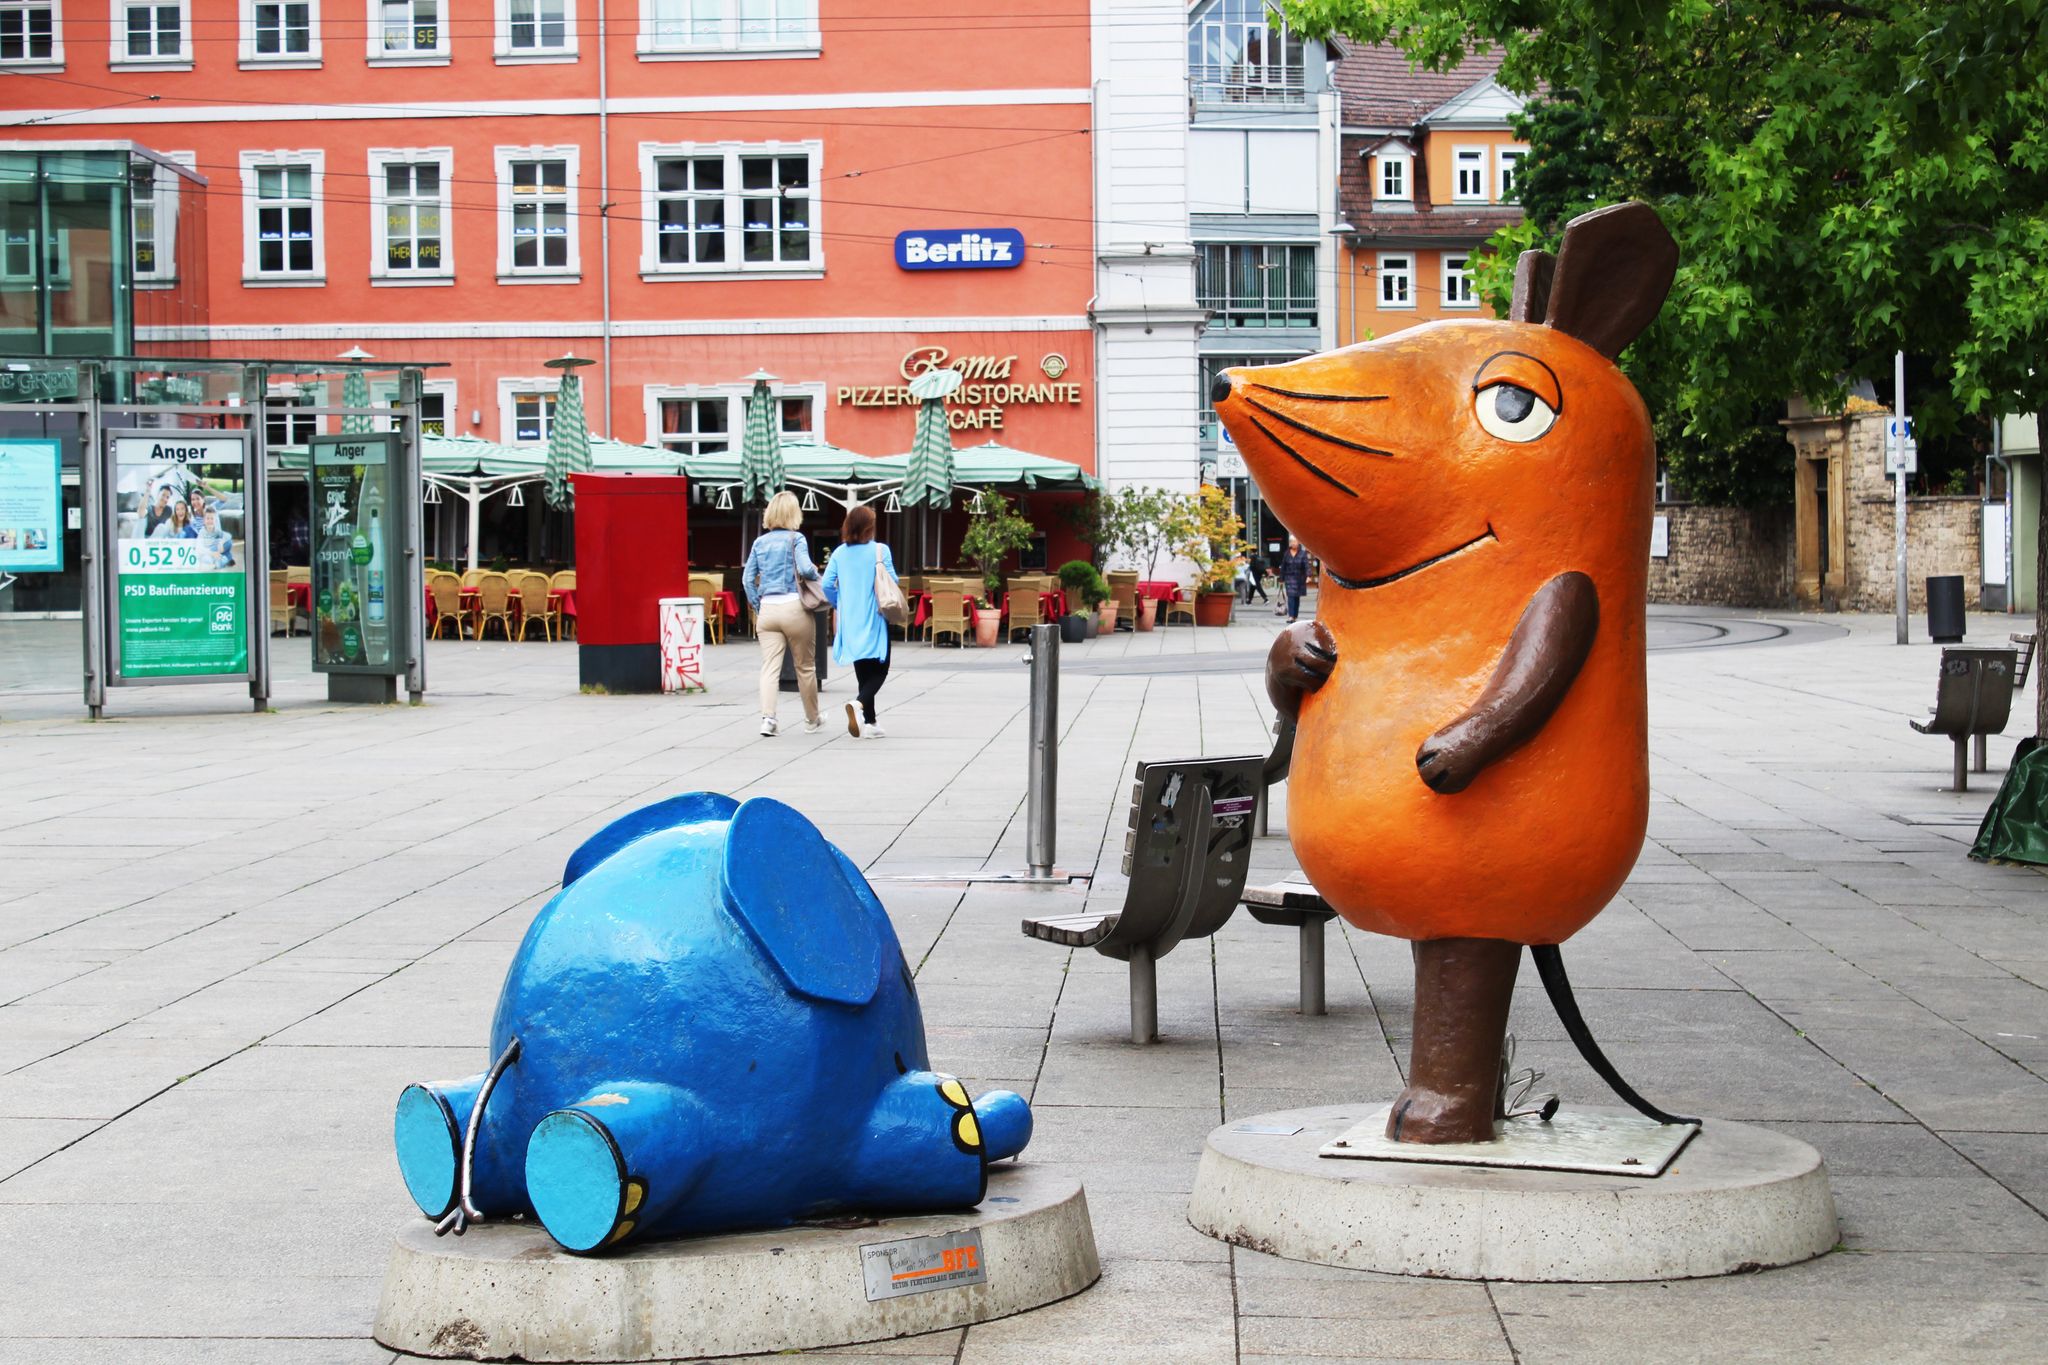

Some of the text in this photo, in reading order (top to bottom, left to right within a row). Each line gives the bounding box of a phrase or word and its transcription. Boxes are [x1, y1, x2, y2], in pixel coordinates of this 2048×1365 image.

[906, 234, 1012, 263] Berlitz
[900, 345, 1018, 381] Roma
[837, 383, 1081, 406] PIZZERI RISTORANTE
[151, 443, 208, 463] Anger
[335, 444, 366, 459] Anger
[129, 547, 173, 568] 0,52
[124, 584, 235, 598] PSD Baufinanzierung
[211, 622, 233, 632] Bank
[867, 1247, 898, 1260] SPONSOR
